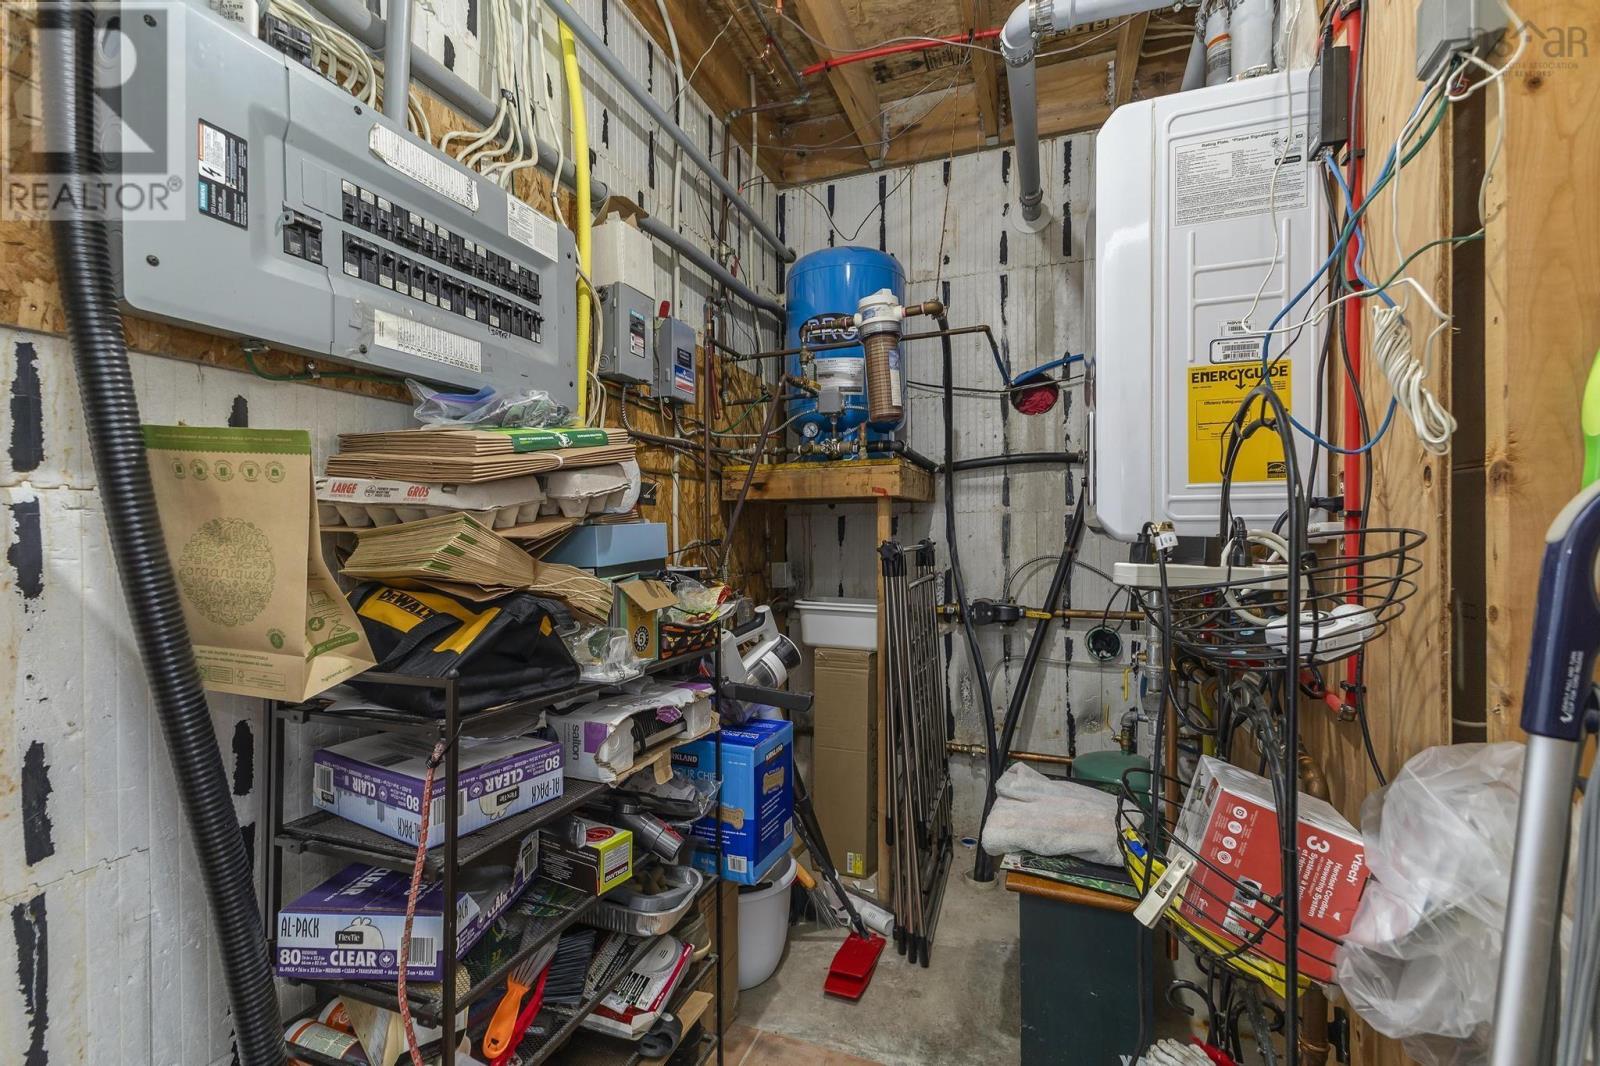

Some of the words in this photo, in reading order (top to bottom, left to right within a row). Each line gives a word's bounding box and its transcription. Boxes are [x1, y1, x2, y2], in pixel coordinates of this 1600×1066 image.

[1191, 365, 1289, 386] ENERGYGUDE
[330, 482, 358, 495] LARGE
[406, 485, 431, 498] GROS
[187, 564, 267, 582] organiques
[572, 724, 581, 760] salton
[544, 755, 560, 771] 80
[352, 776, 376, 797] CLAIR
[484, 768, 524, 793] CLEAR
[532, 777, 560, 804] AL-PACK
[406, 794, 420, 812] 80
[1307, 835, 1330, 853] 3
[1305, 852, 1318, 880] Système
[1316, 858, 1332, 892] Answering
[1328, 862, 1343, 890] Handset
[1345, 853, 1364, 884] vtech
[347, 867, 393, 896] CLEAR
[1308, 894, 1321, 917] System
[1317, 890, 1334, 919] Cordless
[280, 916, 320, 938] AL-PACK
[280, 950, 300, 965] 80
[330, 951, 376, 967] CLEAR
